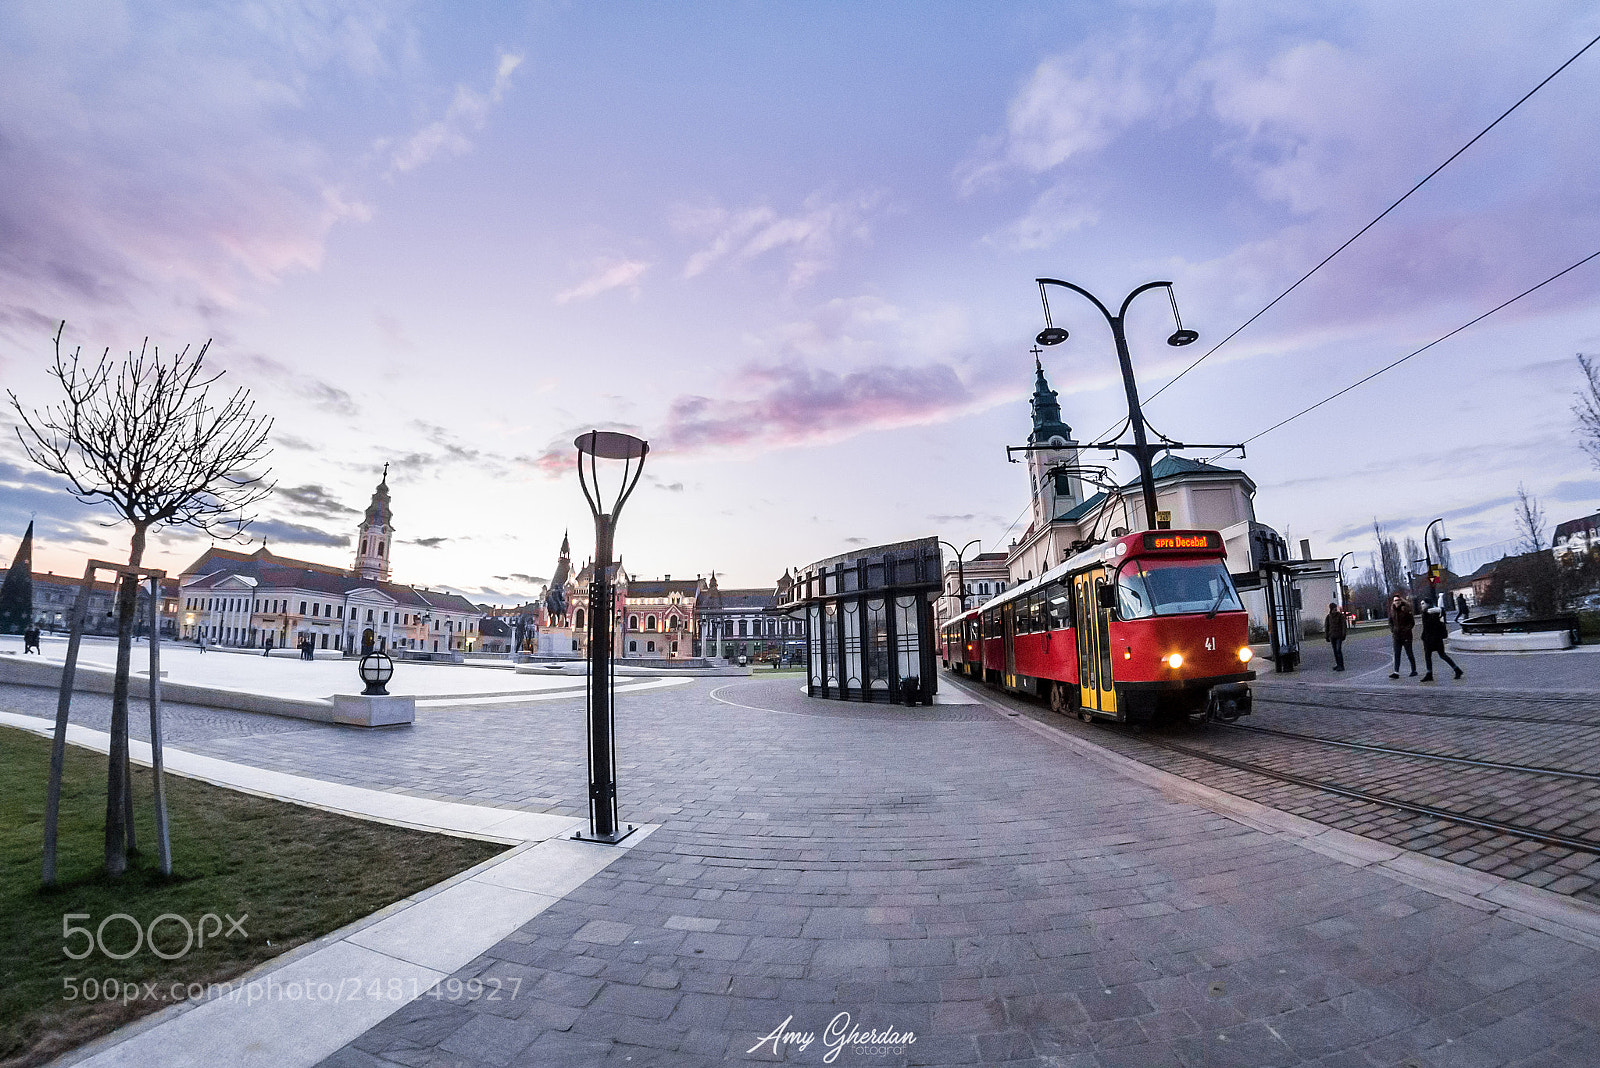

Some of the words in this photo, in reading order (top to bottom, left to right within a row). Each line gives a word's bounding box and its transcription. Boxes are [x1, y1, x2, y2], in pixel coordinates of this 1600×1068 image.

[1155, 538, 1174, 548] spre
[1175, 535, 1208, 548] Decebal
[1205, 637, 1216, 651] 41
